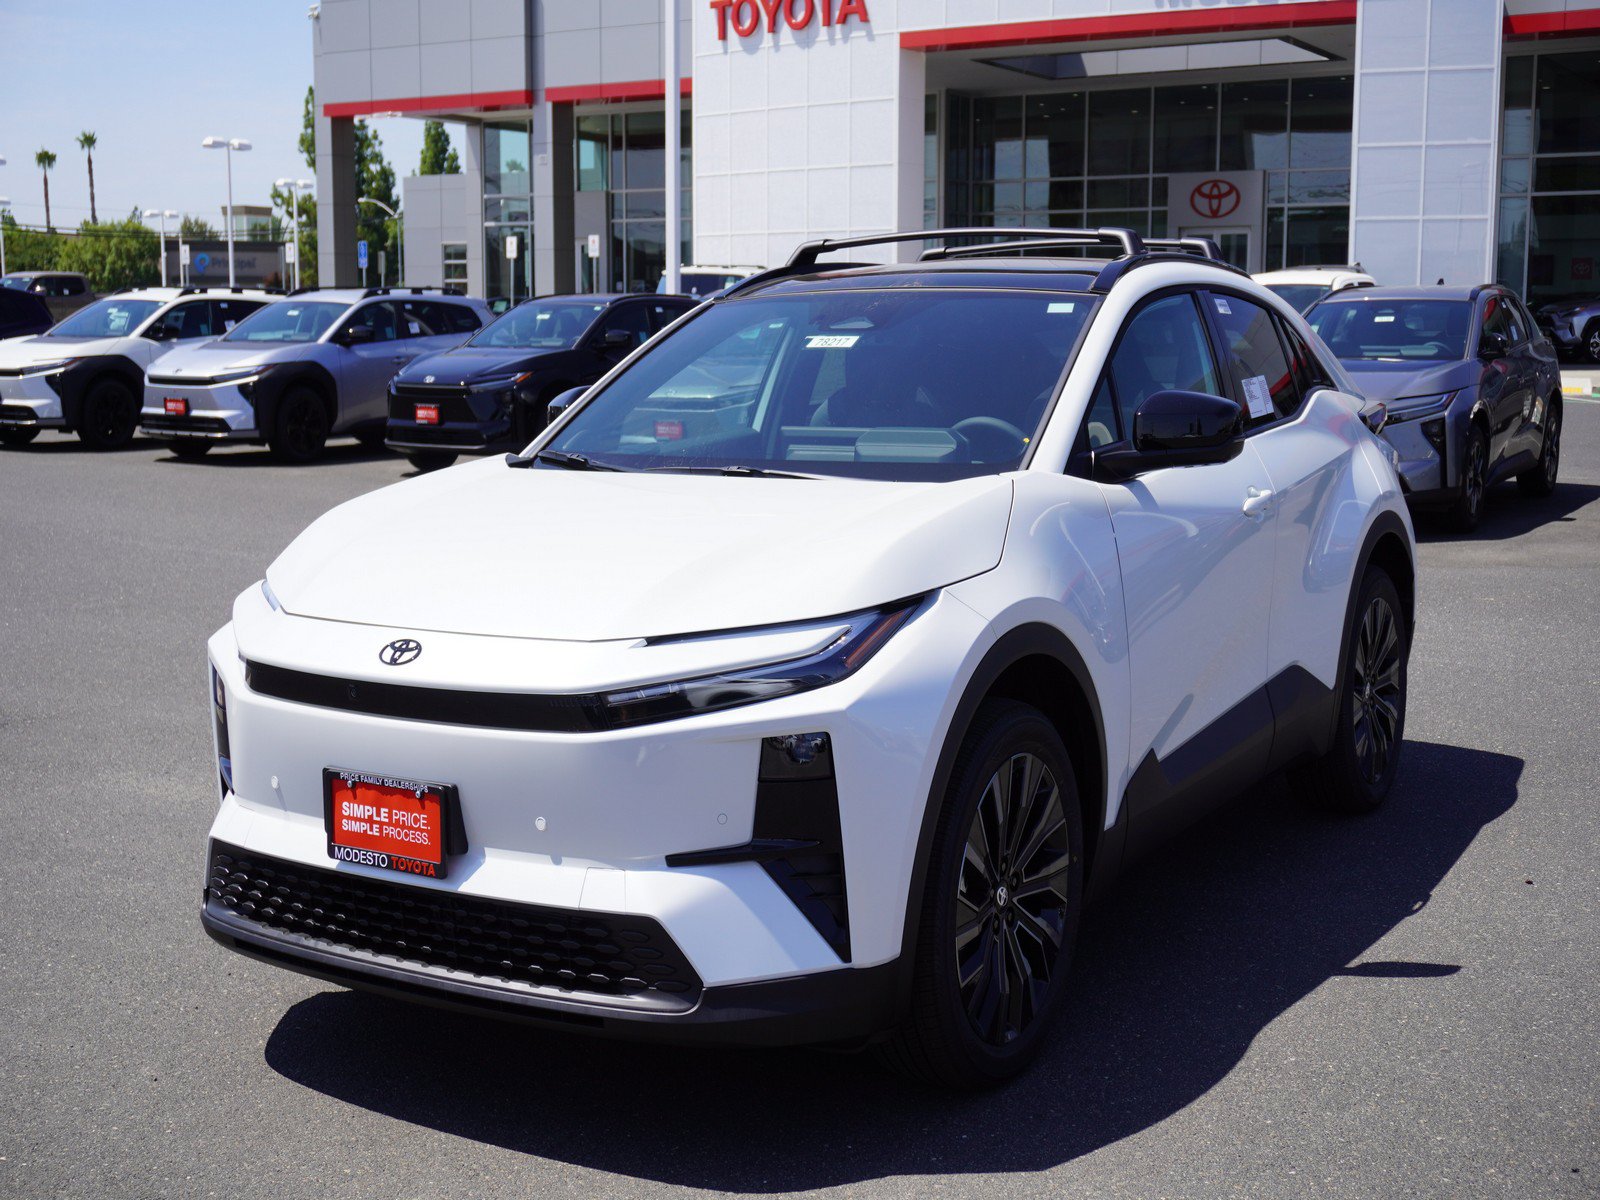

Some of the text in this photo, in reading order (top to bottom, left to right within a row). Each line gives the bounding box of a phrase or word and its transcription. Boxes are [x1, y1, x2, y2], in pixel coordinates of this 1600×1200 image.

[710, 0, 870, 41] TOYOTA
[340, 772, 428, 793] PRICE FAMILY DEALERSHIPS
[341, 801, 430, 830] SIMPLE PRICE.
[341, 818, 431, 845] SIMPLE PROCESS.
[334, 846, 436, 877] MODESTO TOYOTA
